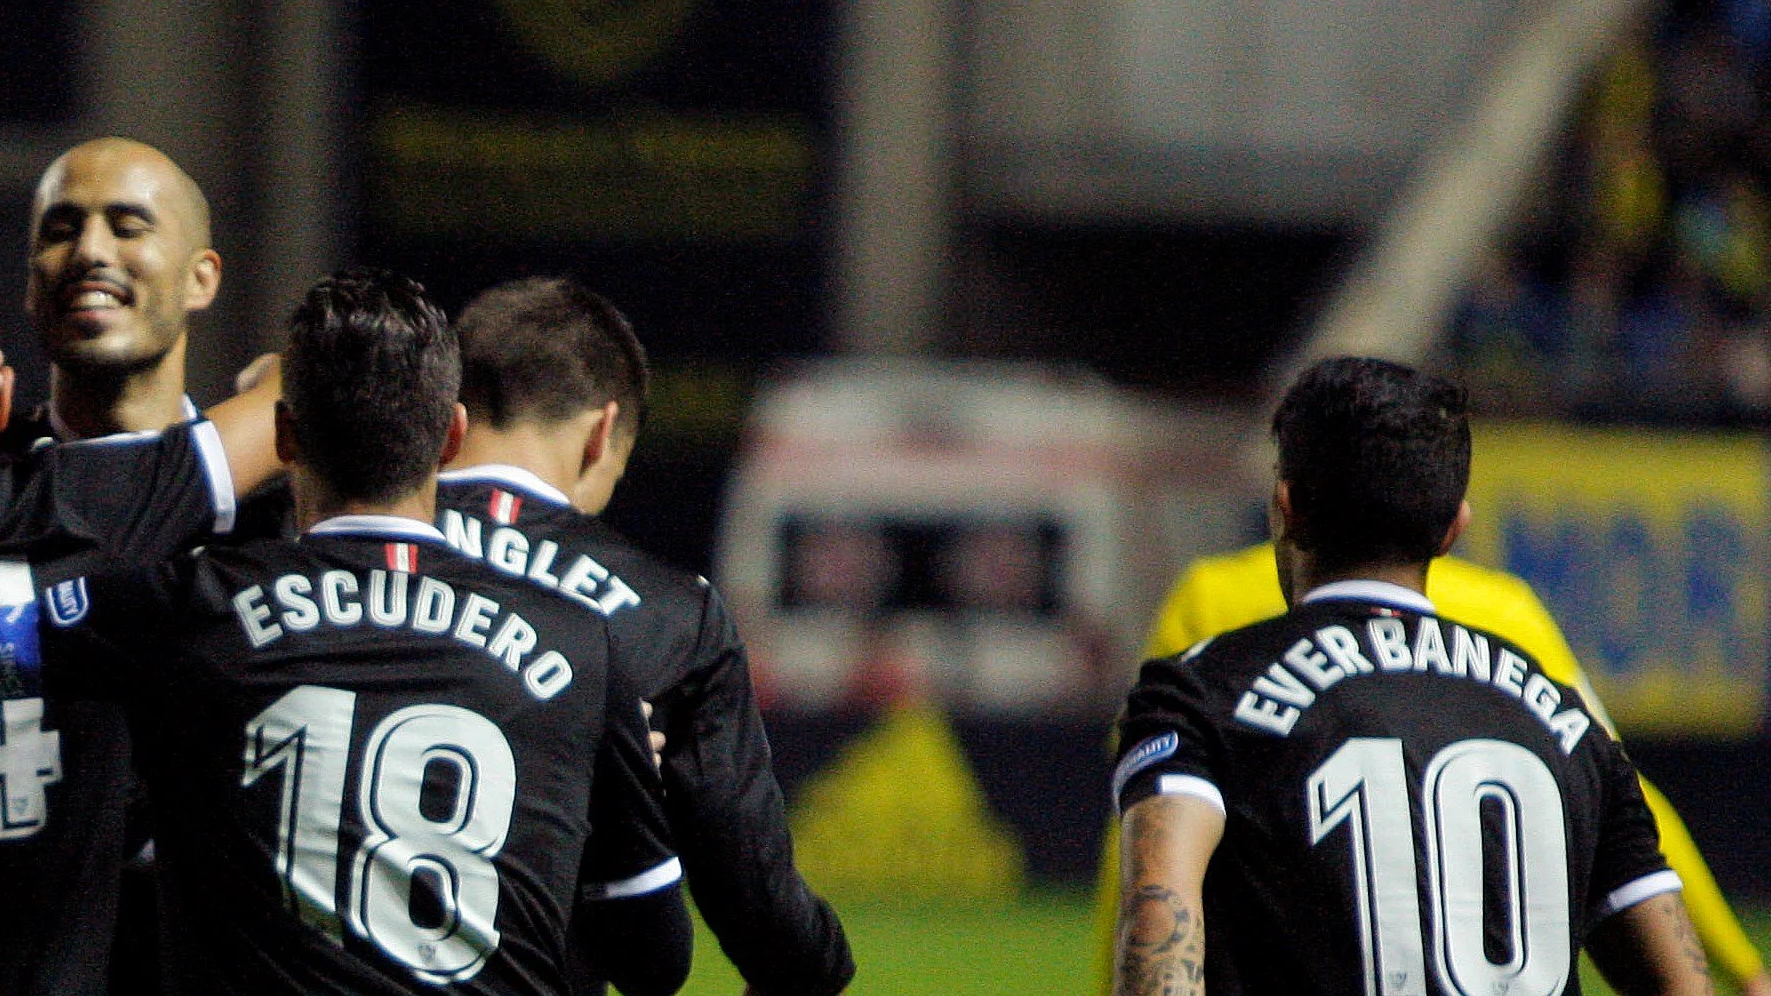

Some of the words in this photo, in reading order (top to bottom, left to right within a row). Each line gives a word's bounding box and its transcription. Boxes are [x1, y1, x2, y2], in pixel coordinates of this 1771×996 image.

[435, 509, 642, 620] NGLET
[232, 570, 575, 702] ESCUDERO
[1234, 625, 1374, 738] EVER
[1368, 616, 1592, 756] BANEGA
[240, 685, 518, 987] 18
